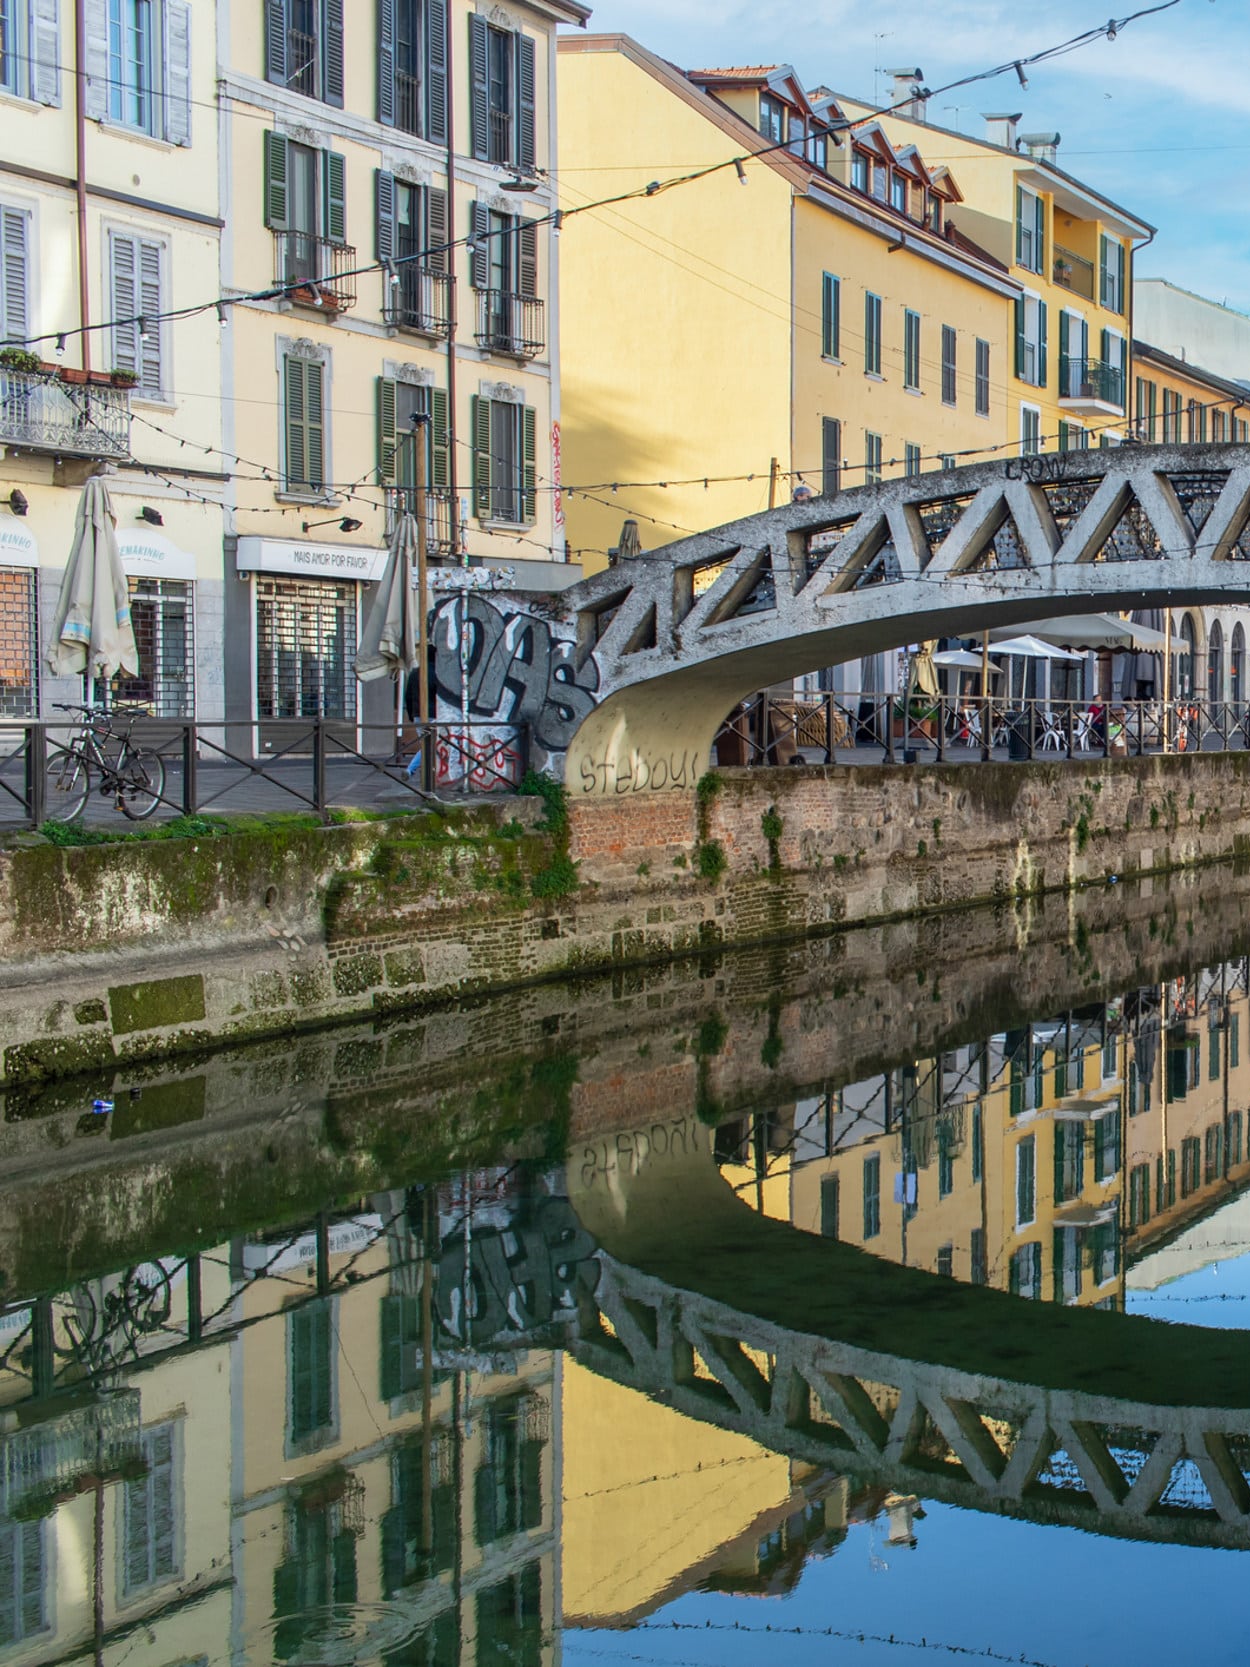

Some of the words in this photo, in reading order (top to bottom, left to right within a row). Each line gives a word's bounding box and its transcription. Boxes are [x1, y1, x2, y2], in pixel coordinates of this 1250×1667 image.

[1005, 455, 1066, 481] CROW
[293, 550, 311, 564] MAIS
[311, 552, 331, 566] AMOR
[331, 553, 346, 567] POR
[346, 555, 368, 569] FAVOR
